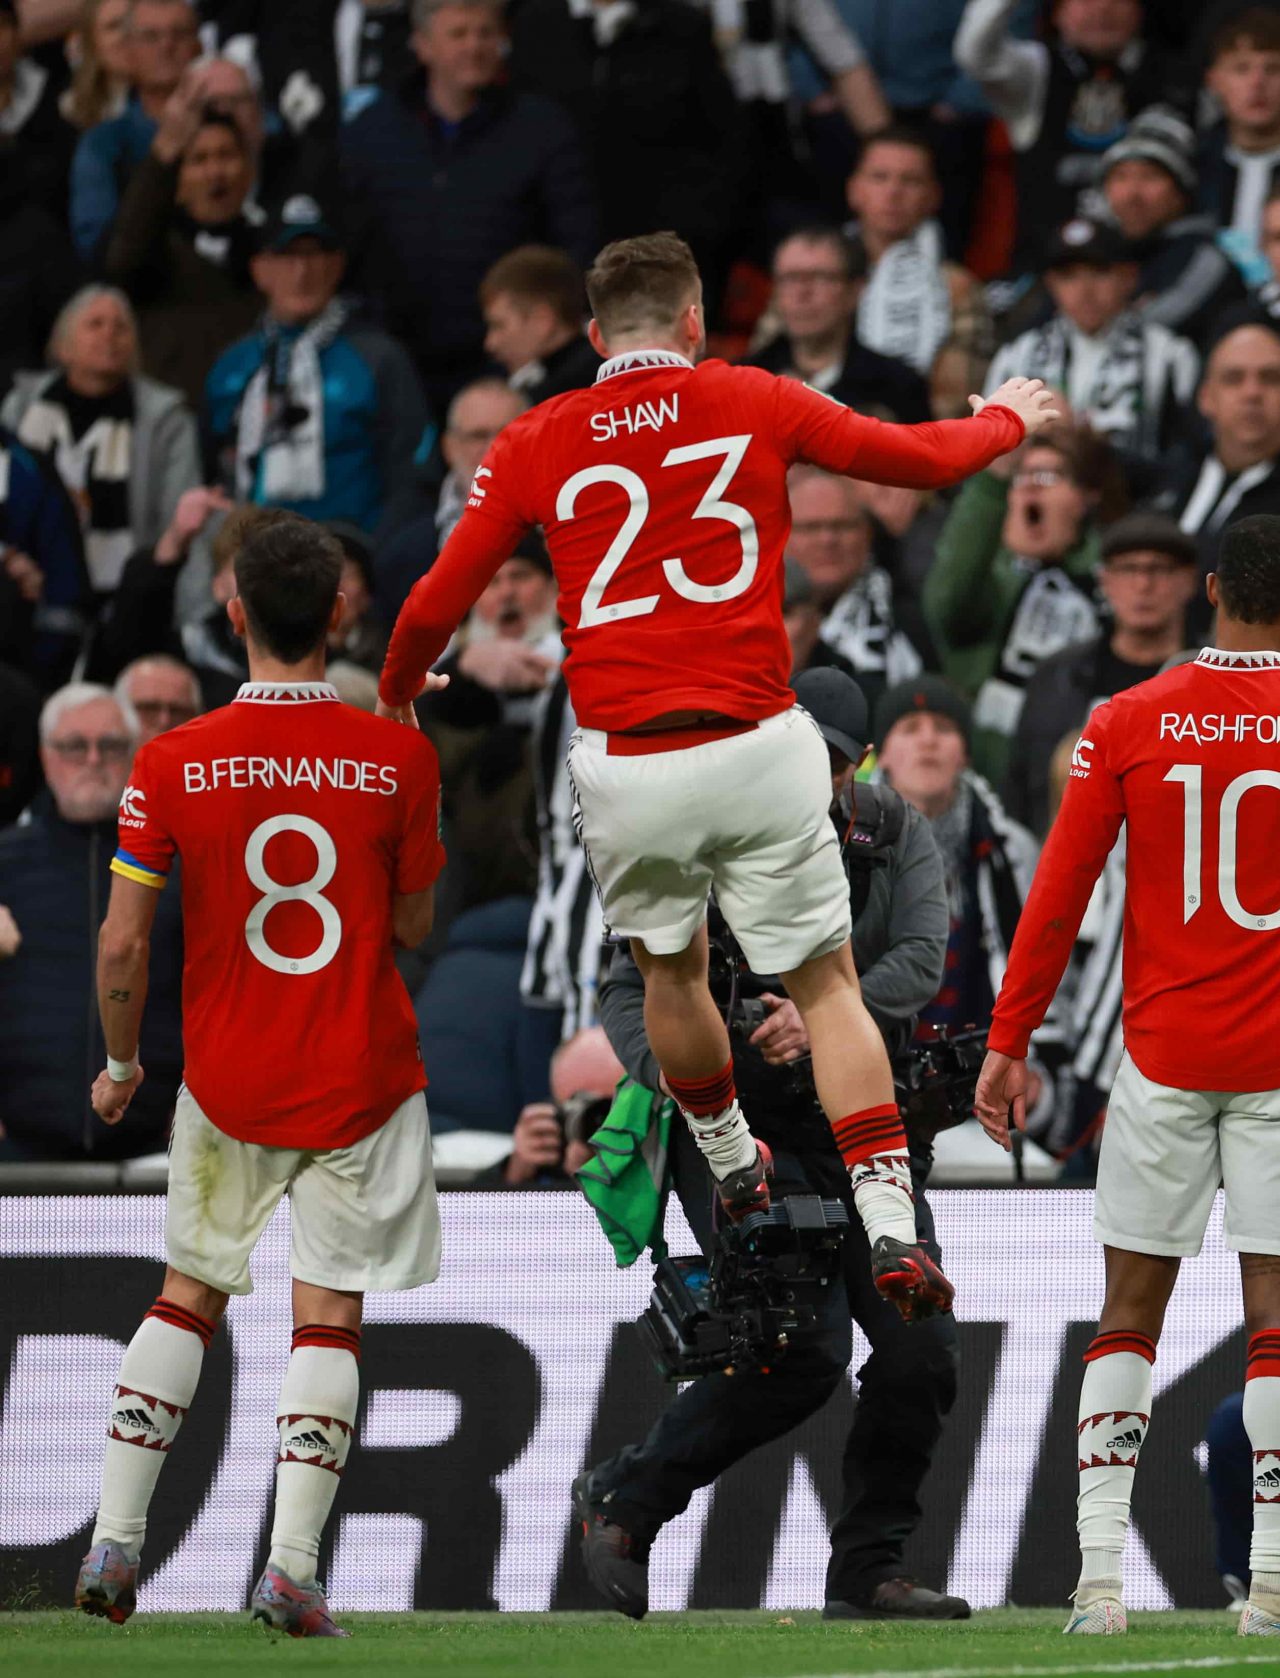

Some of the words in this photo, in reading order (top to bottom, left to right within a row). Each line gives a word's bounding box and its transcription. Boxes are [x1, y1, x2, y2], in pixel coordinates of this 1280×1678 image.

[590, 392, 679, 442] SHAW
[556, 434, 759, 629] 23
[183, 756, 398, 796] B.FERNANDES
[244, 813, 342, 975] 8
[111, 1412, 160, 1434] adidas
[284, 1439, 337, 1455] adidas
[1106, 1439, 1140, 1450] adida
